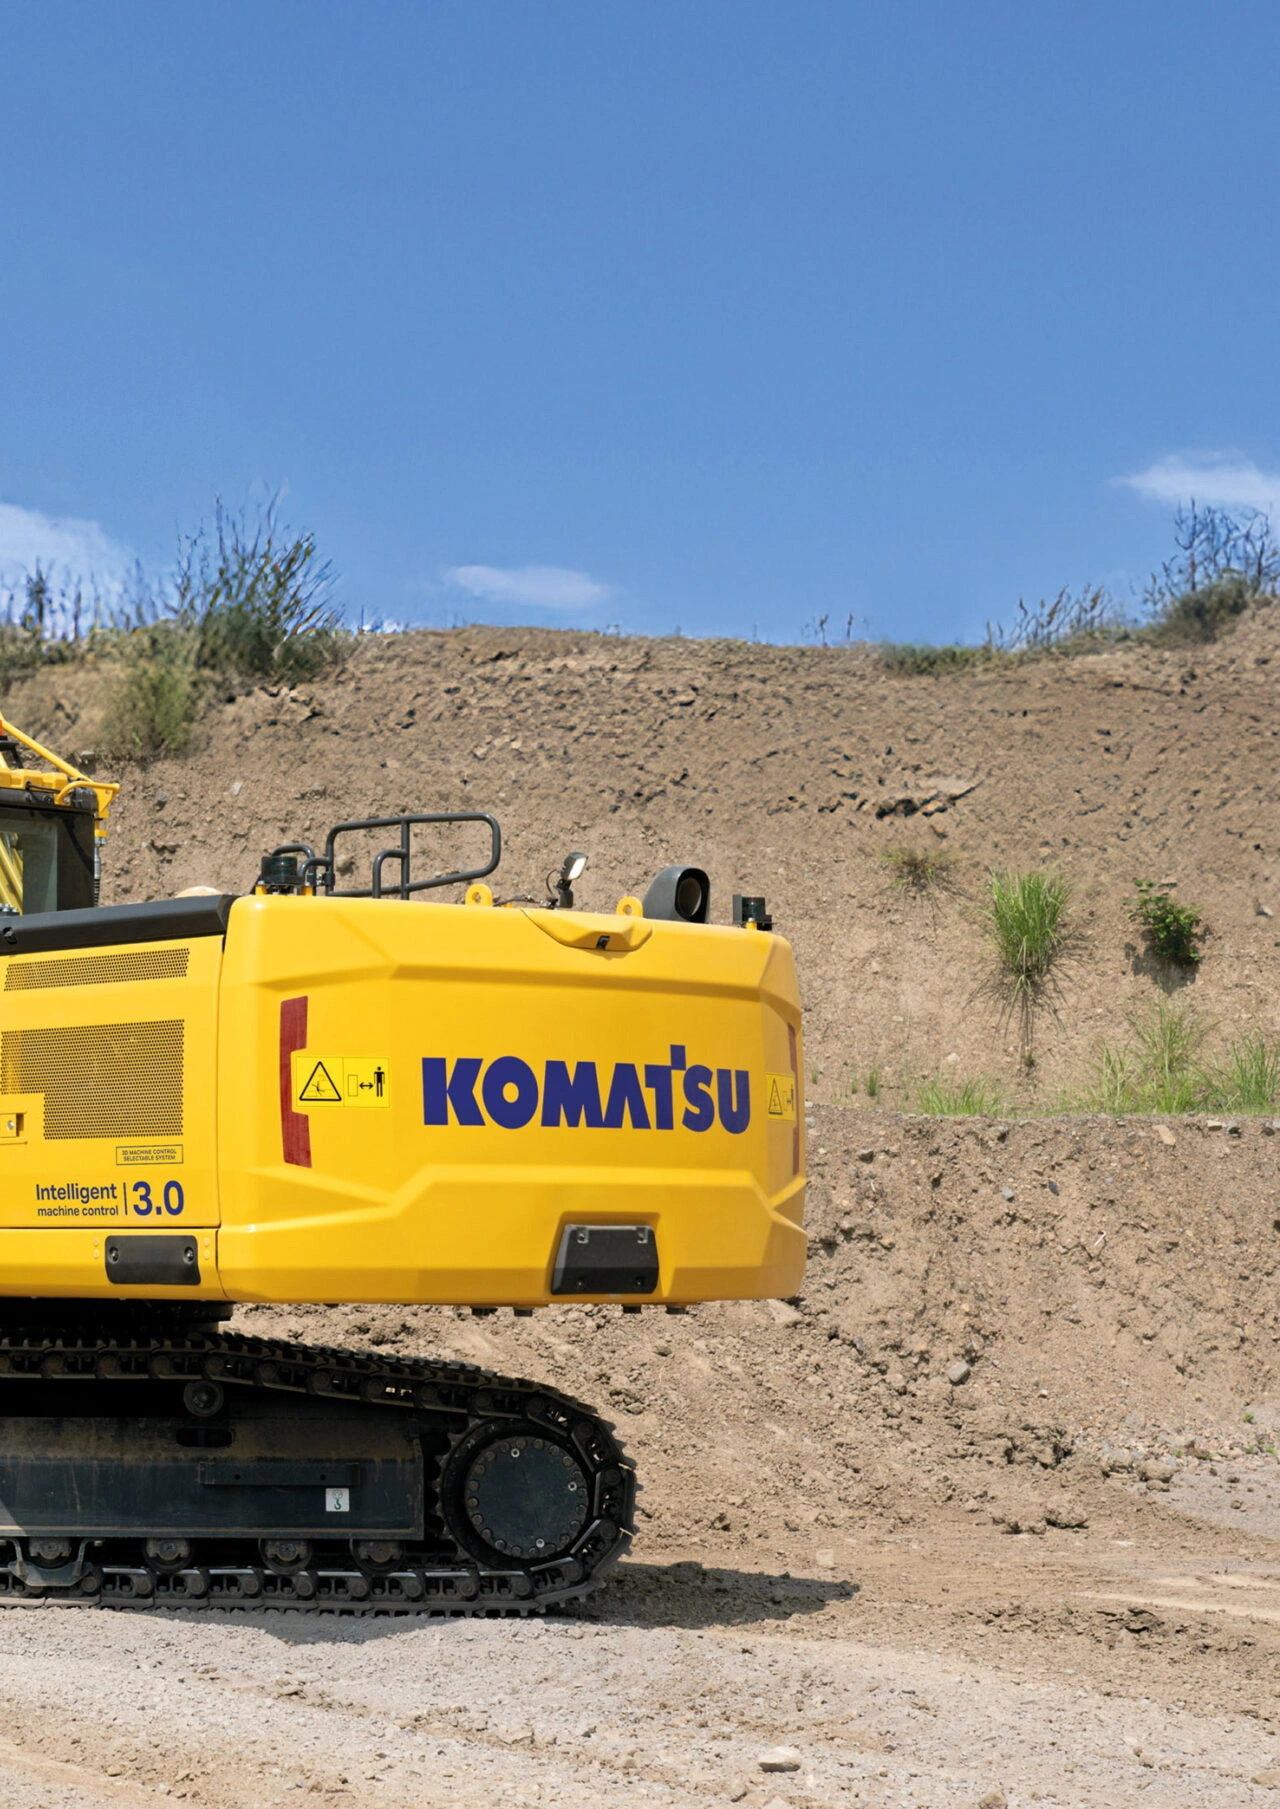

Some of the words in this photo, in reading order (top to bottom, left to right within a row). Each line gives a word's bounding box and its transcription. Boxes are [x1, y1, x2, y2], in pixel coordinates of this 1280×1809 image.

[422, 1044, 751, 1134] KOMATSU
[36, 1183, 117, 1204] Intelligent
[132, 1180, 184, 1216] 3.0
[37, 1205, 80, 1216] machine
[81, 1205, 119, 1216] control
